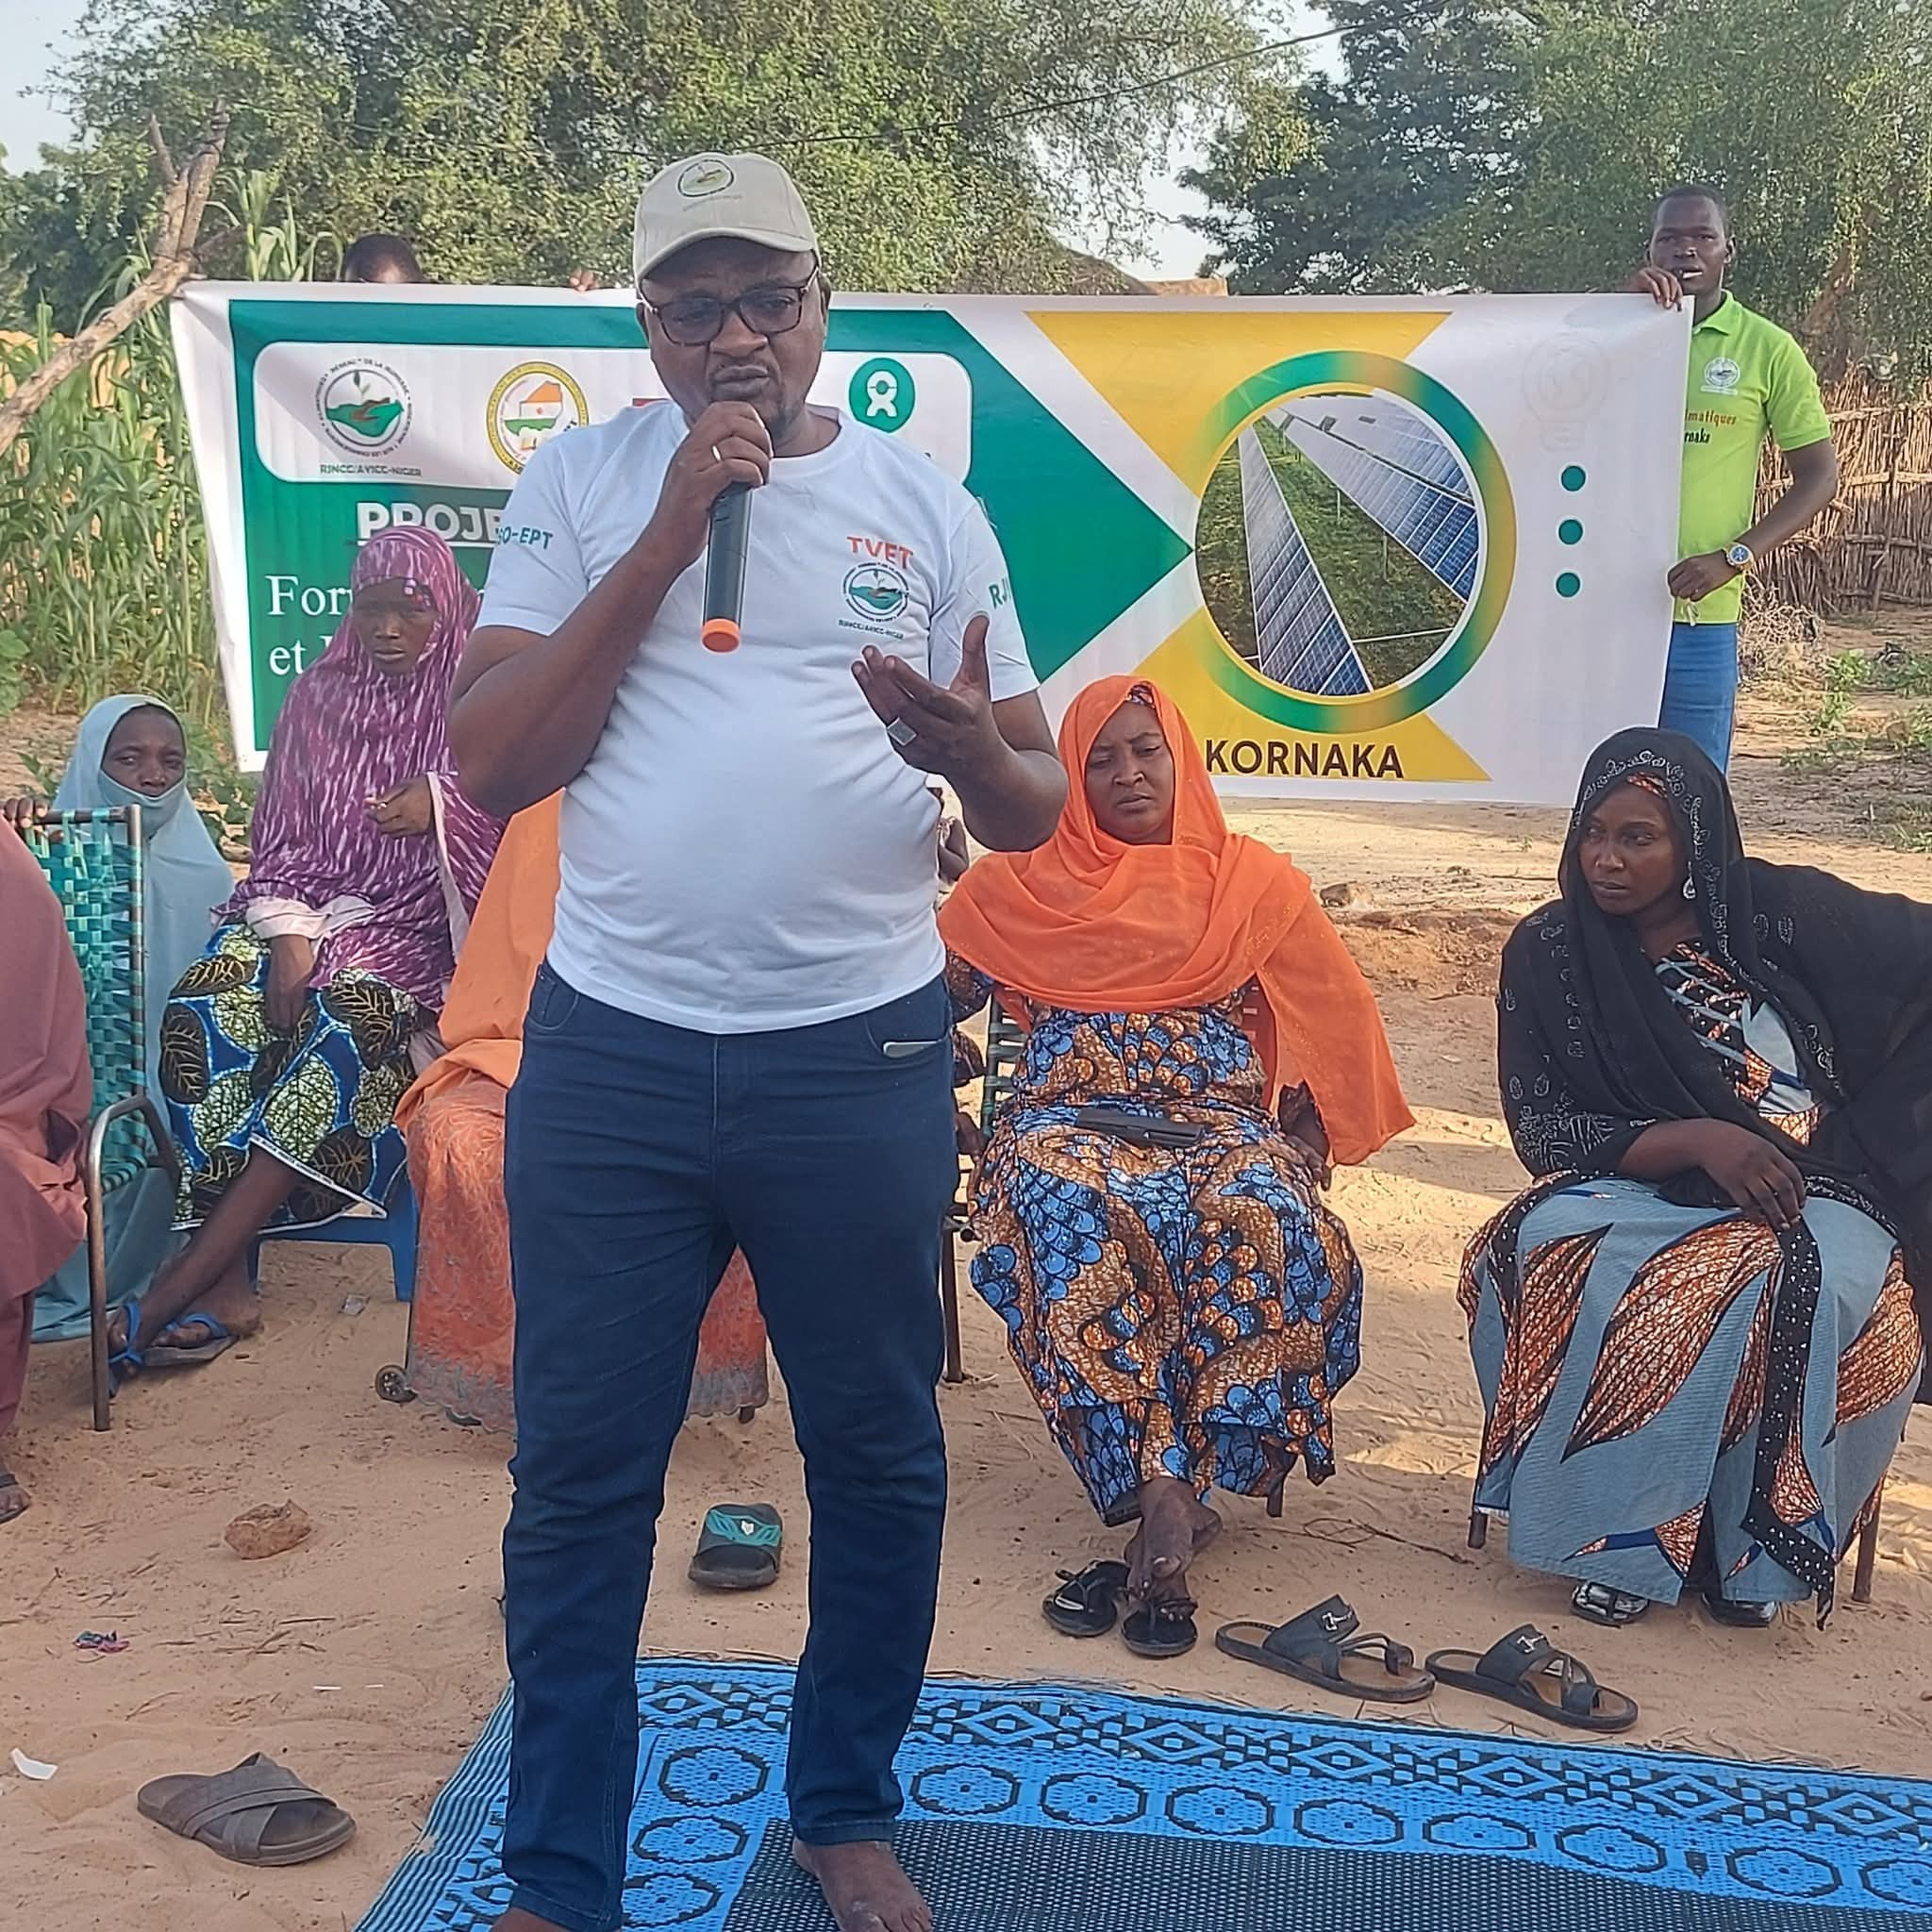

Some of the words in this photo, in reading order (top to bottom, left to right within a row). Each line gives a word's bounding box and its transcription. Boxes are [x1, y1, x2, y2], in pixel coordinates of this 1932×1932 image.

[847, 536, 914, 570] TVET
[269, 640, 307, 676] et
[1207, 739, 1405, 779] KORNAKA
